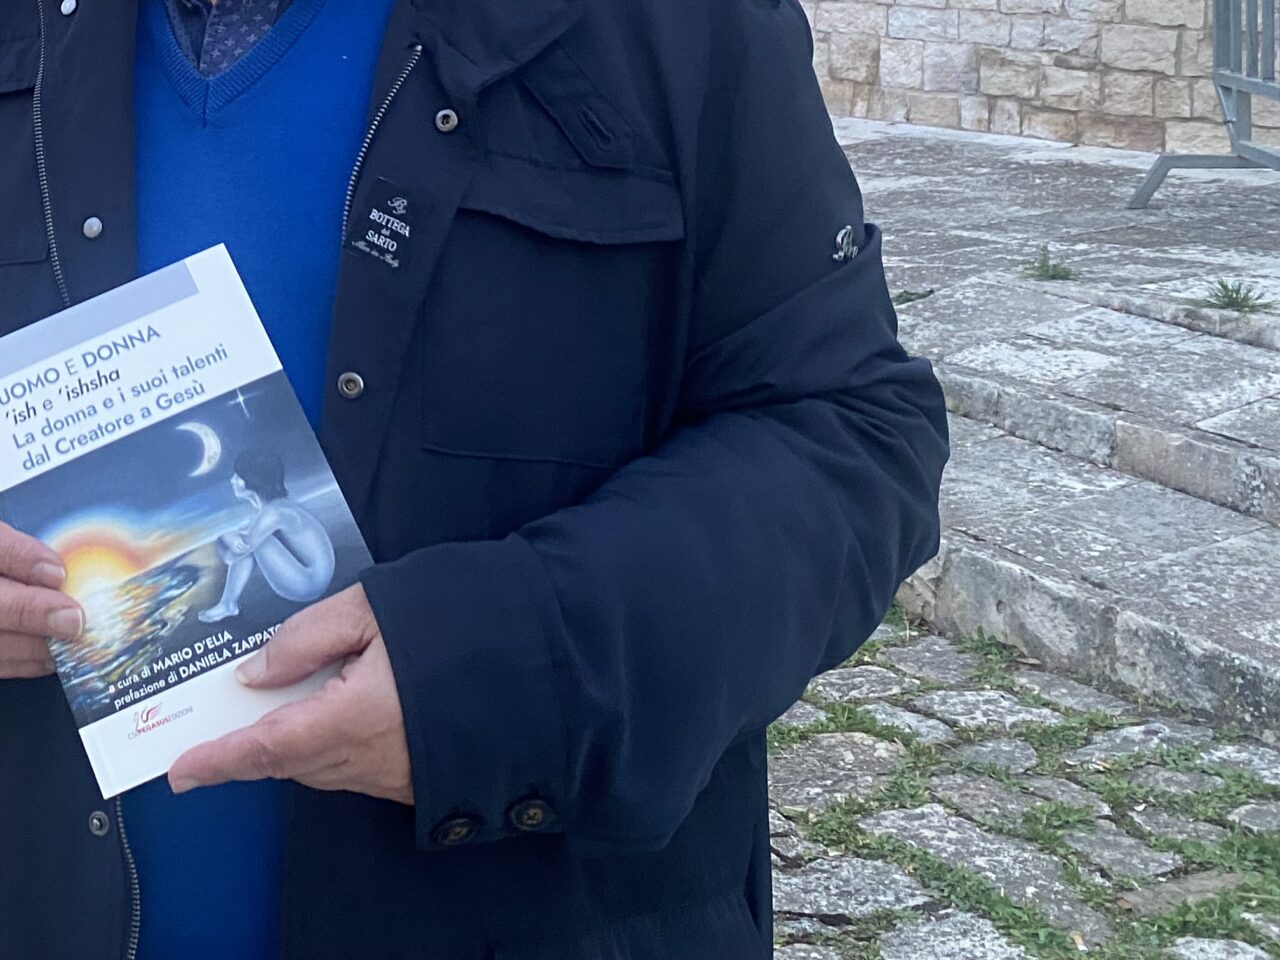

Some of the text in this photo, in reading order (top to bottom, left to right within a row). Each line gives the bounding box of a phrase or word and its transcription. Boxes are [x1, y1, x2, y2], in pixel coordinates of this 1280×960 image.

[365, 230, 397, 252] SARTO
[368, 208, 410, 238] BOTTEGA
[64, 358, 78, 377] E
[81, 325, 162, 369] DONNA
[12, 343, 229, 450] La donna e i suoi talenti
[42, 398, 54, 411] e
[22, 379, 206, 471] dal Creatore a Gesù
[108, 630, 234, 693] a cura di MARIO D'ELIA
[114, 679, 167, 710] prefazione
[167, 671, 179, 686] di
[179, 649, 232, 679] DANIELA
